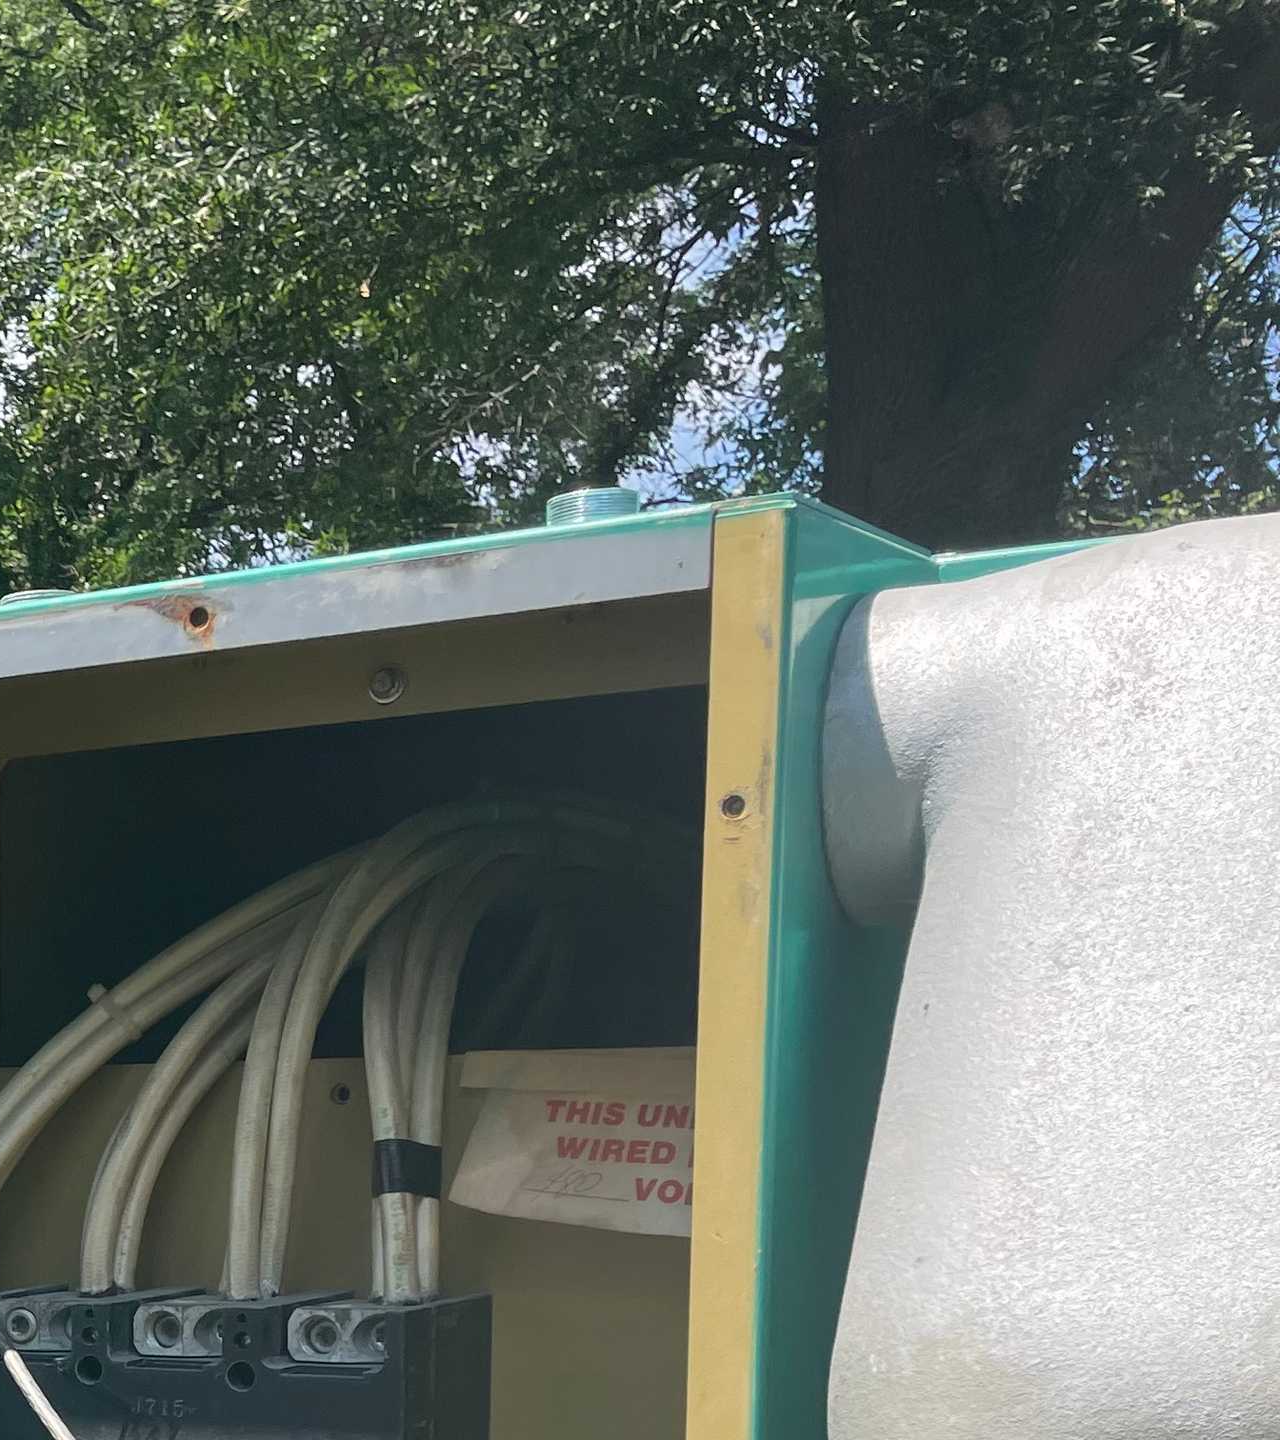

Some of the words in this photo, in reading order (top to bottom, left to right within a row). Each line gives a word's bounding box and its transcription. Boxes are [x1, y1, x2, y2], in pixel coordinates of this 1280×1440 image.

[546, 1100, 626, 1126] THIS
[637, 1104, 695, 1130] UN
[556, 1136, 676, 1165] WIRED
